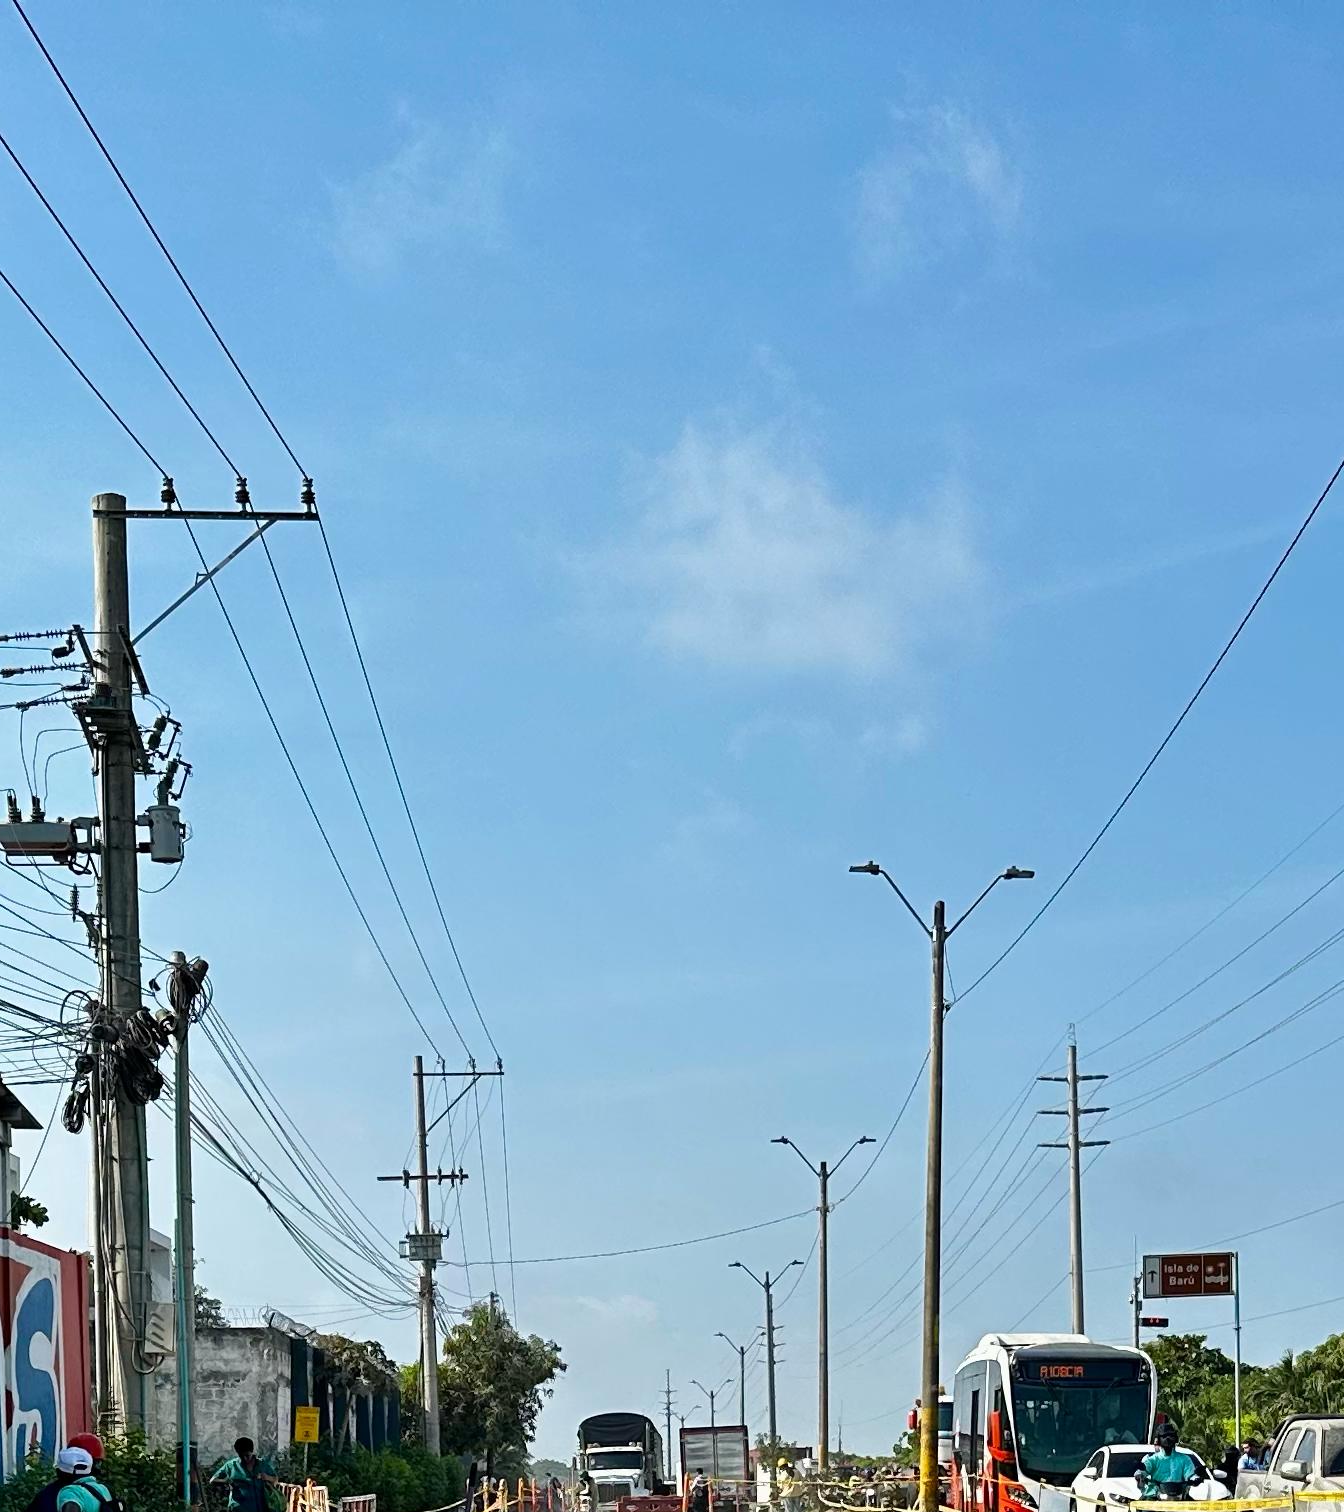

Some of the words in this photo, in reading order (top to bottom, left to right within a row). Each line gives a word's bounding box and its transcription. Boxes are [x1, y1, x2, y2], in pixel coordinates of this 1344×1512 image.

[1164, 1263, 1183, 1273] Isla
[1186, 1263, 1199, 1273] de
[1169, 1275, 1195, 1286] Barú
